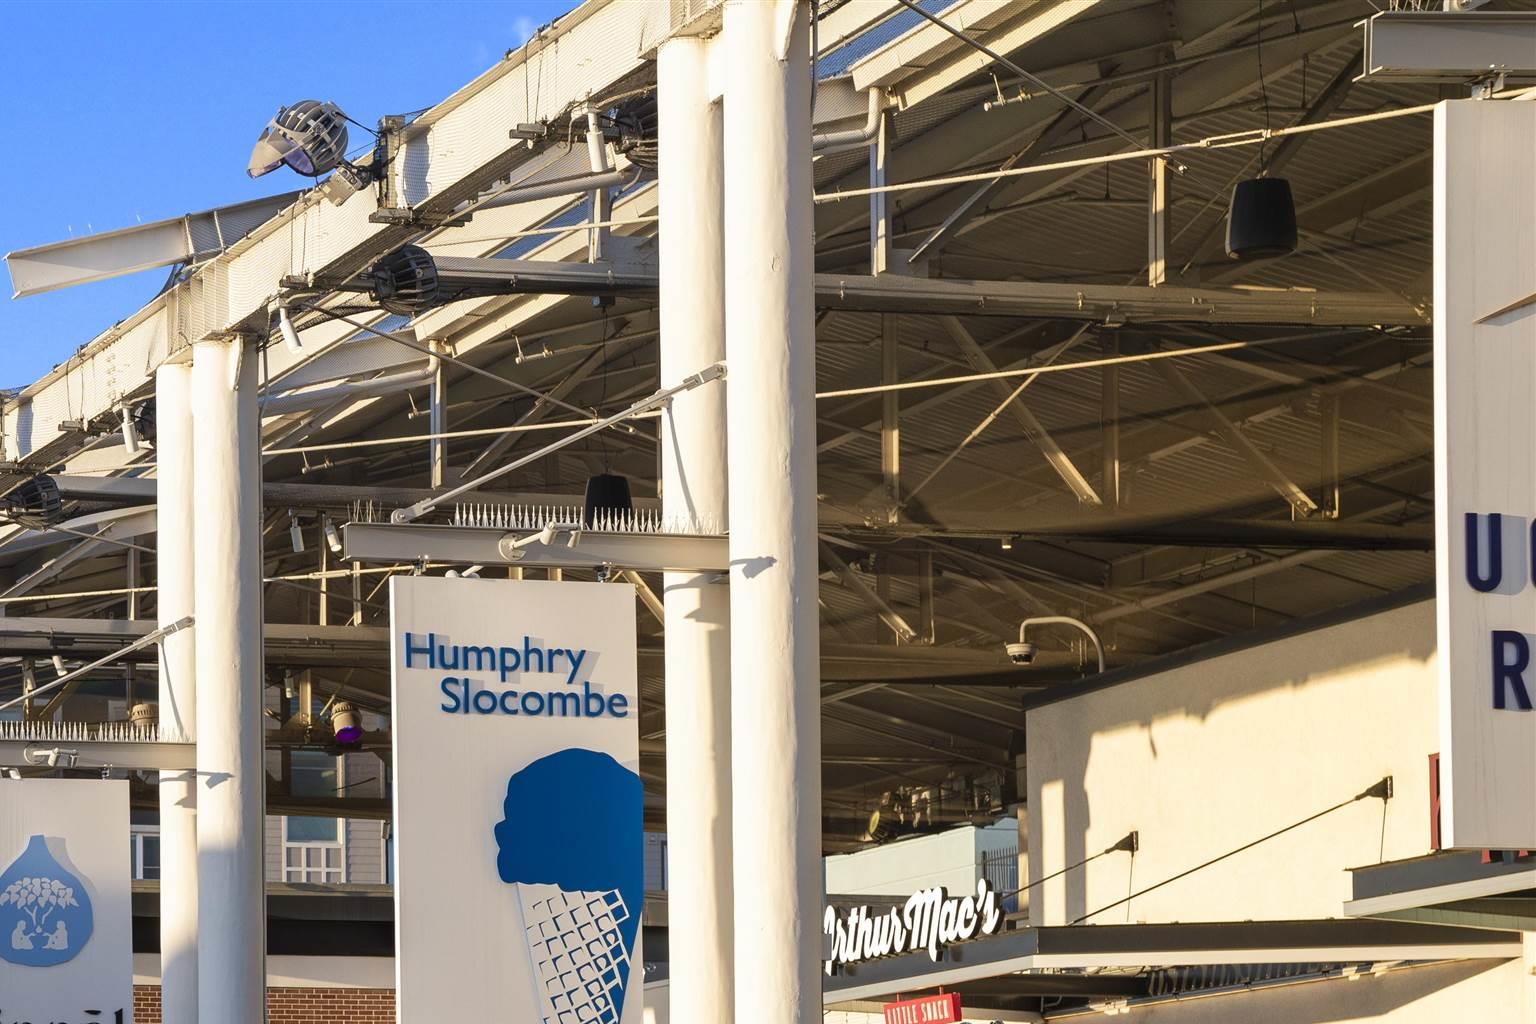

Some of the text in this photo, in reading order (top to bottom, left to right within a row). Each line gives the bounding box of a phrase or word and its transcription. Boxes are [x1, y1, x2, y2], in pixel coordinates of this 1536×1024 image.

[405, 632, 587, 684] Humphry
[440, 677, 629, 718] Slocombe
[904, 878, 1000, 962] Mac's
[921, 999, 950, 1022] SNACK
